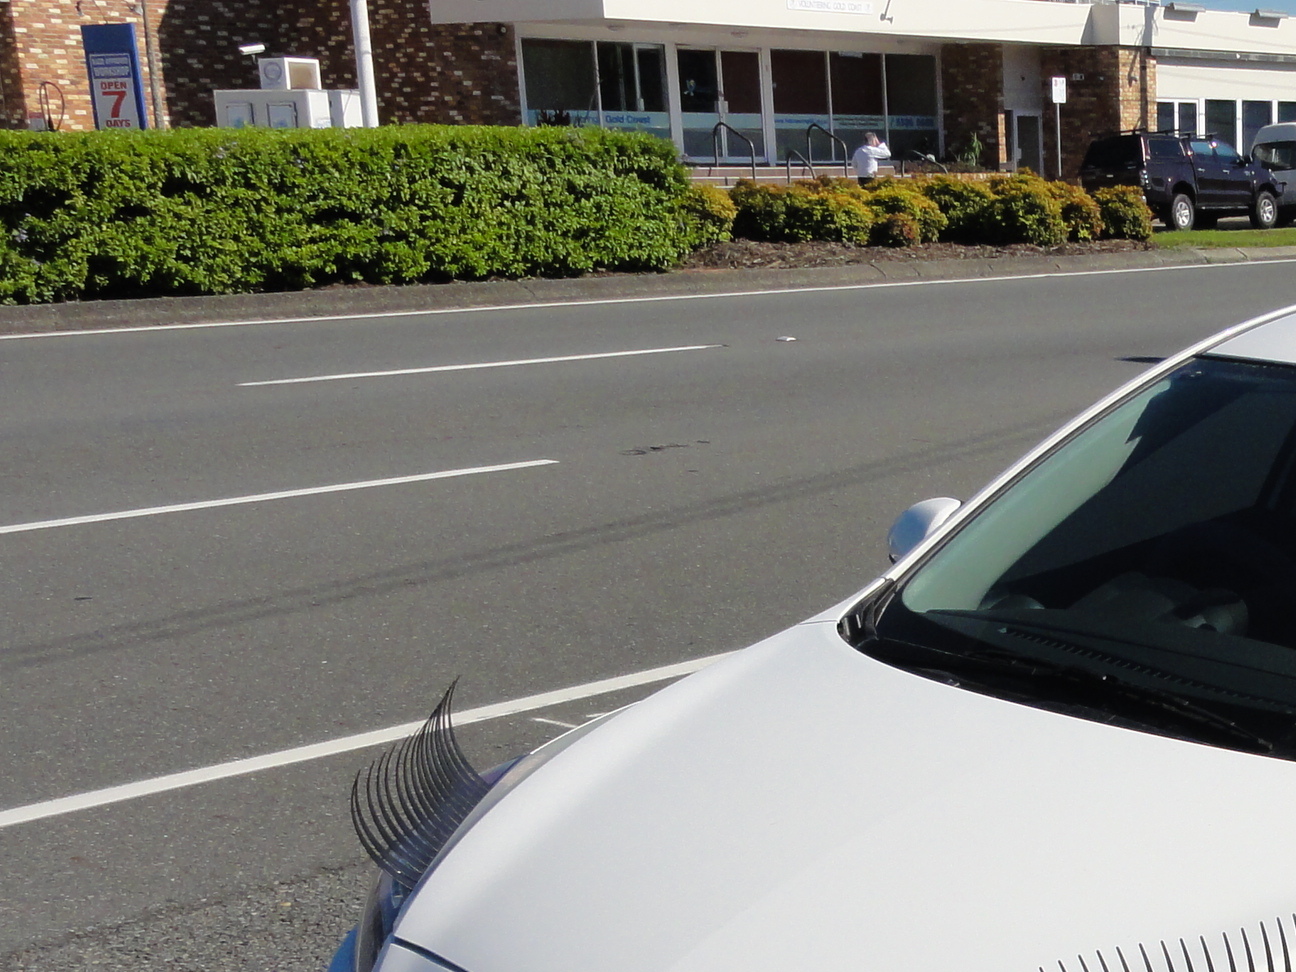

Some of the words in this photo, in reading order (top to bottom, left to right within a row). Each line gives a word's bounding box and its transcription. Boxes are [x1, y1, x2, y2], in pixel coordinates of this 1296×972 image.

[100, 81, 128, 90] OPEN
[102, 90, 128, 119] 7
[105, 119, 131, 128] DAYS
